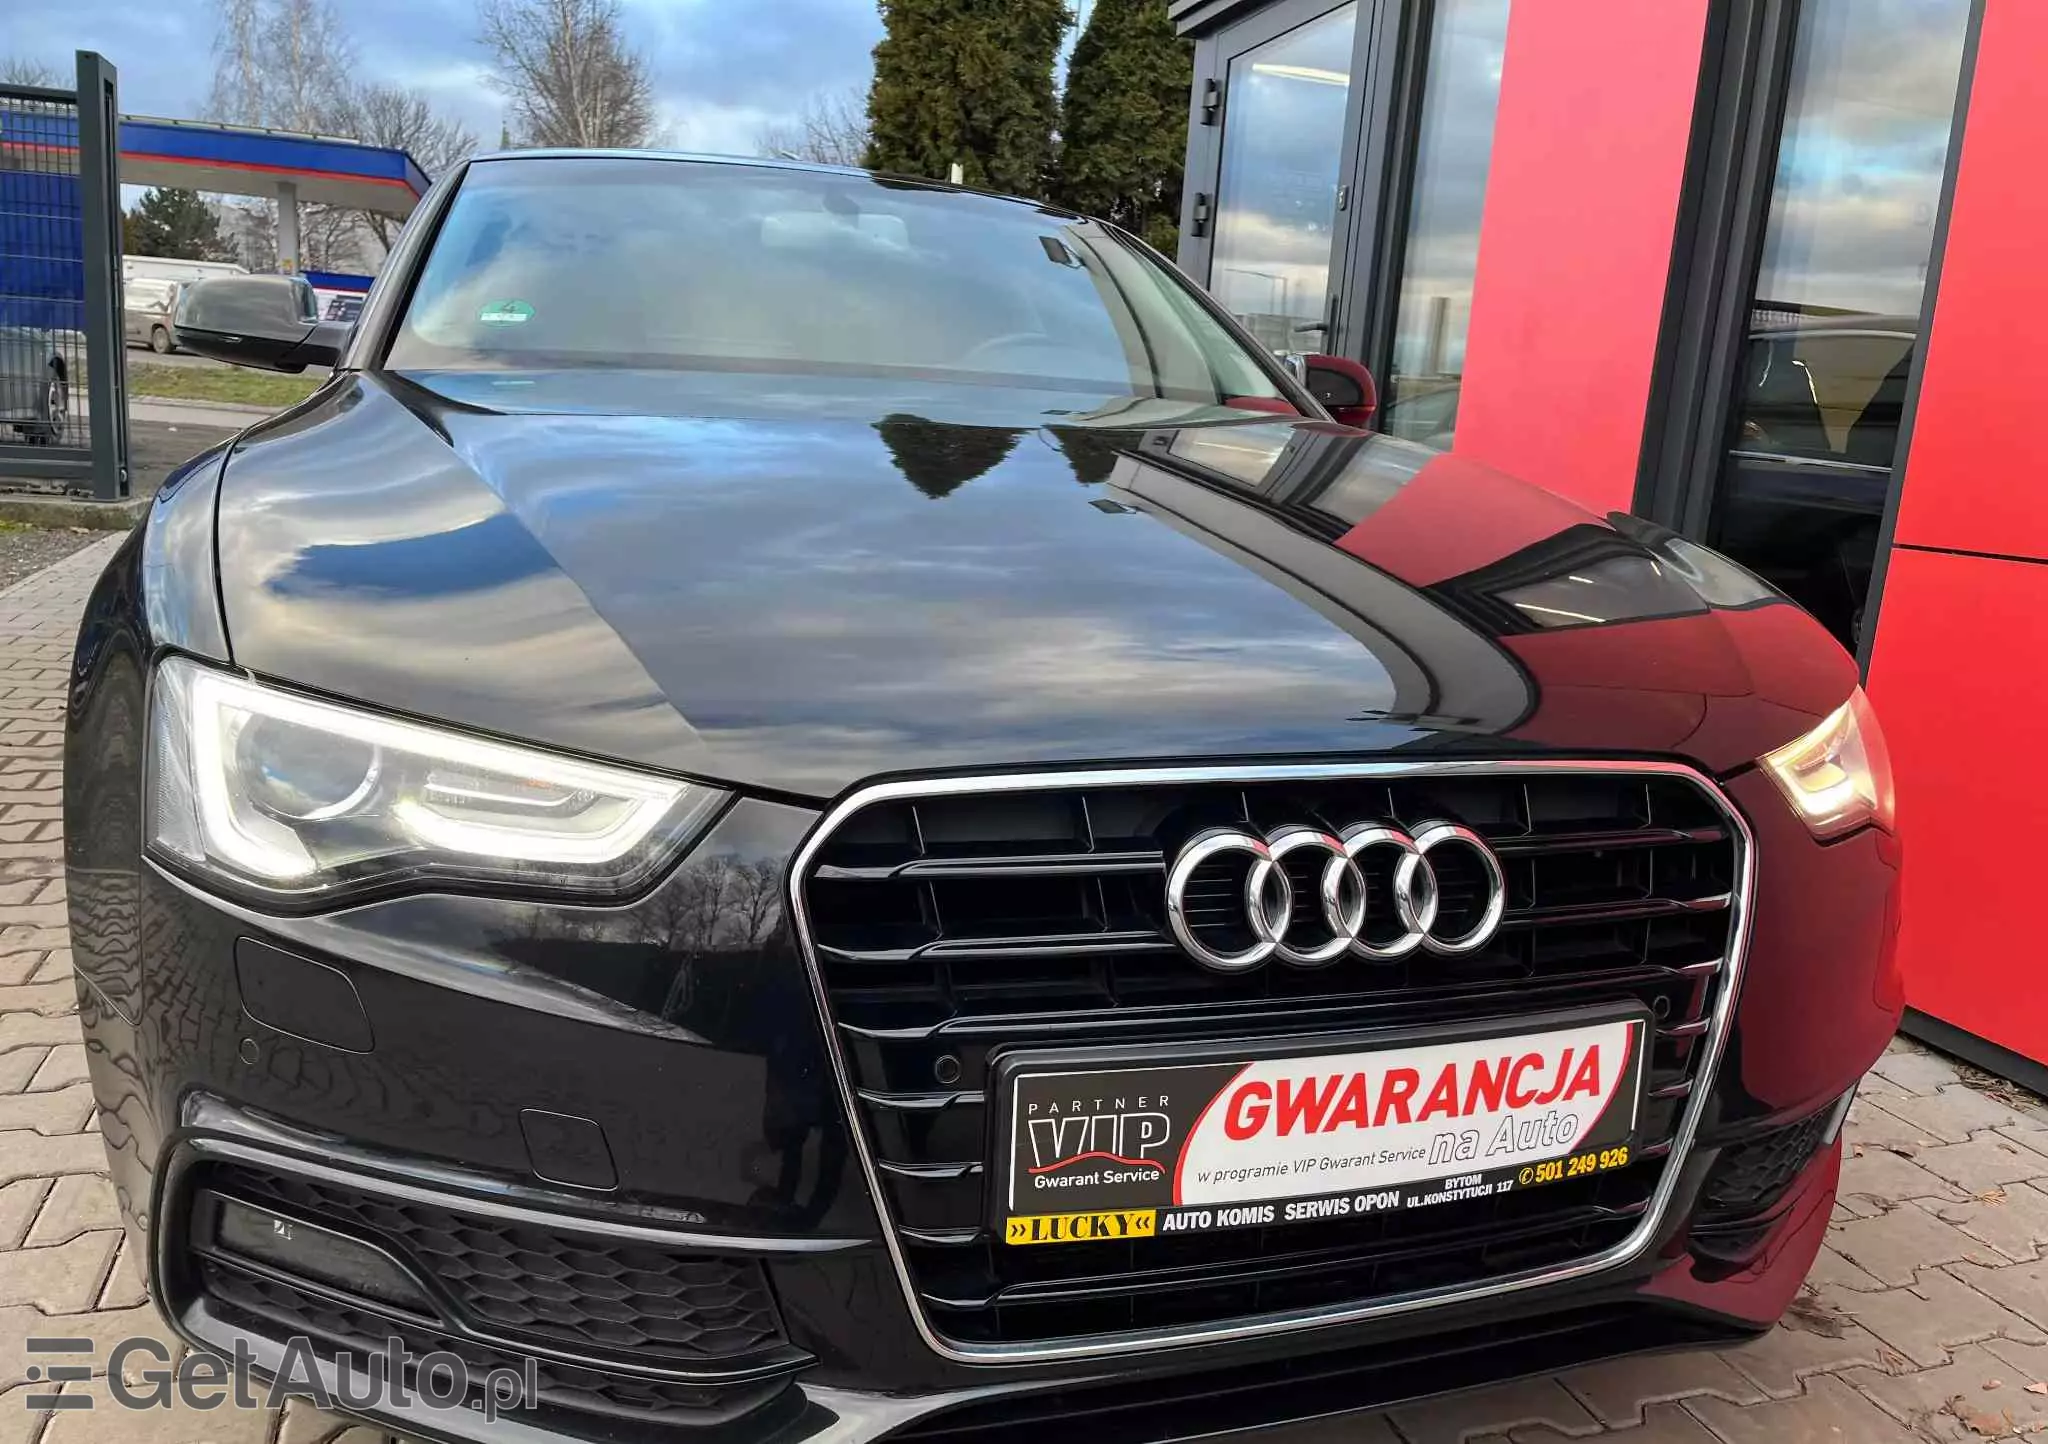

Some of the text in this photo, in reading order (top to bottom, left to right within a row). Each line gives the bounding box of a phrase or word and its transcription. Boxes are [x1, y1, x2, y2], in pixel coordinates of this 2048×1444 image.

[1028, 1095, 1169, 1116] PARTNER
[1224, 1044, 1601, 1141] GWARANCJA
[1028, 1112, 1171, 1168] VIP
[1428, 1110, 1579, 1165] na Auto
[1034, 1169, 1160, 1189] Gwarant Service
[1197, 1146, 1426, 1185] w programie VIP Gwarant Service
[1535, 1146, 1629, 1183] 501 249 926
[1445, 1173, 1482, 1190] BYTOM
[1496, 1180, 1514, 1193] 117
[1162, 1205, 1275, 1231] AUTO KOMIS
[1284, 1191, 1400, 1221] SERWIS OPON
